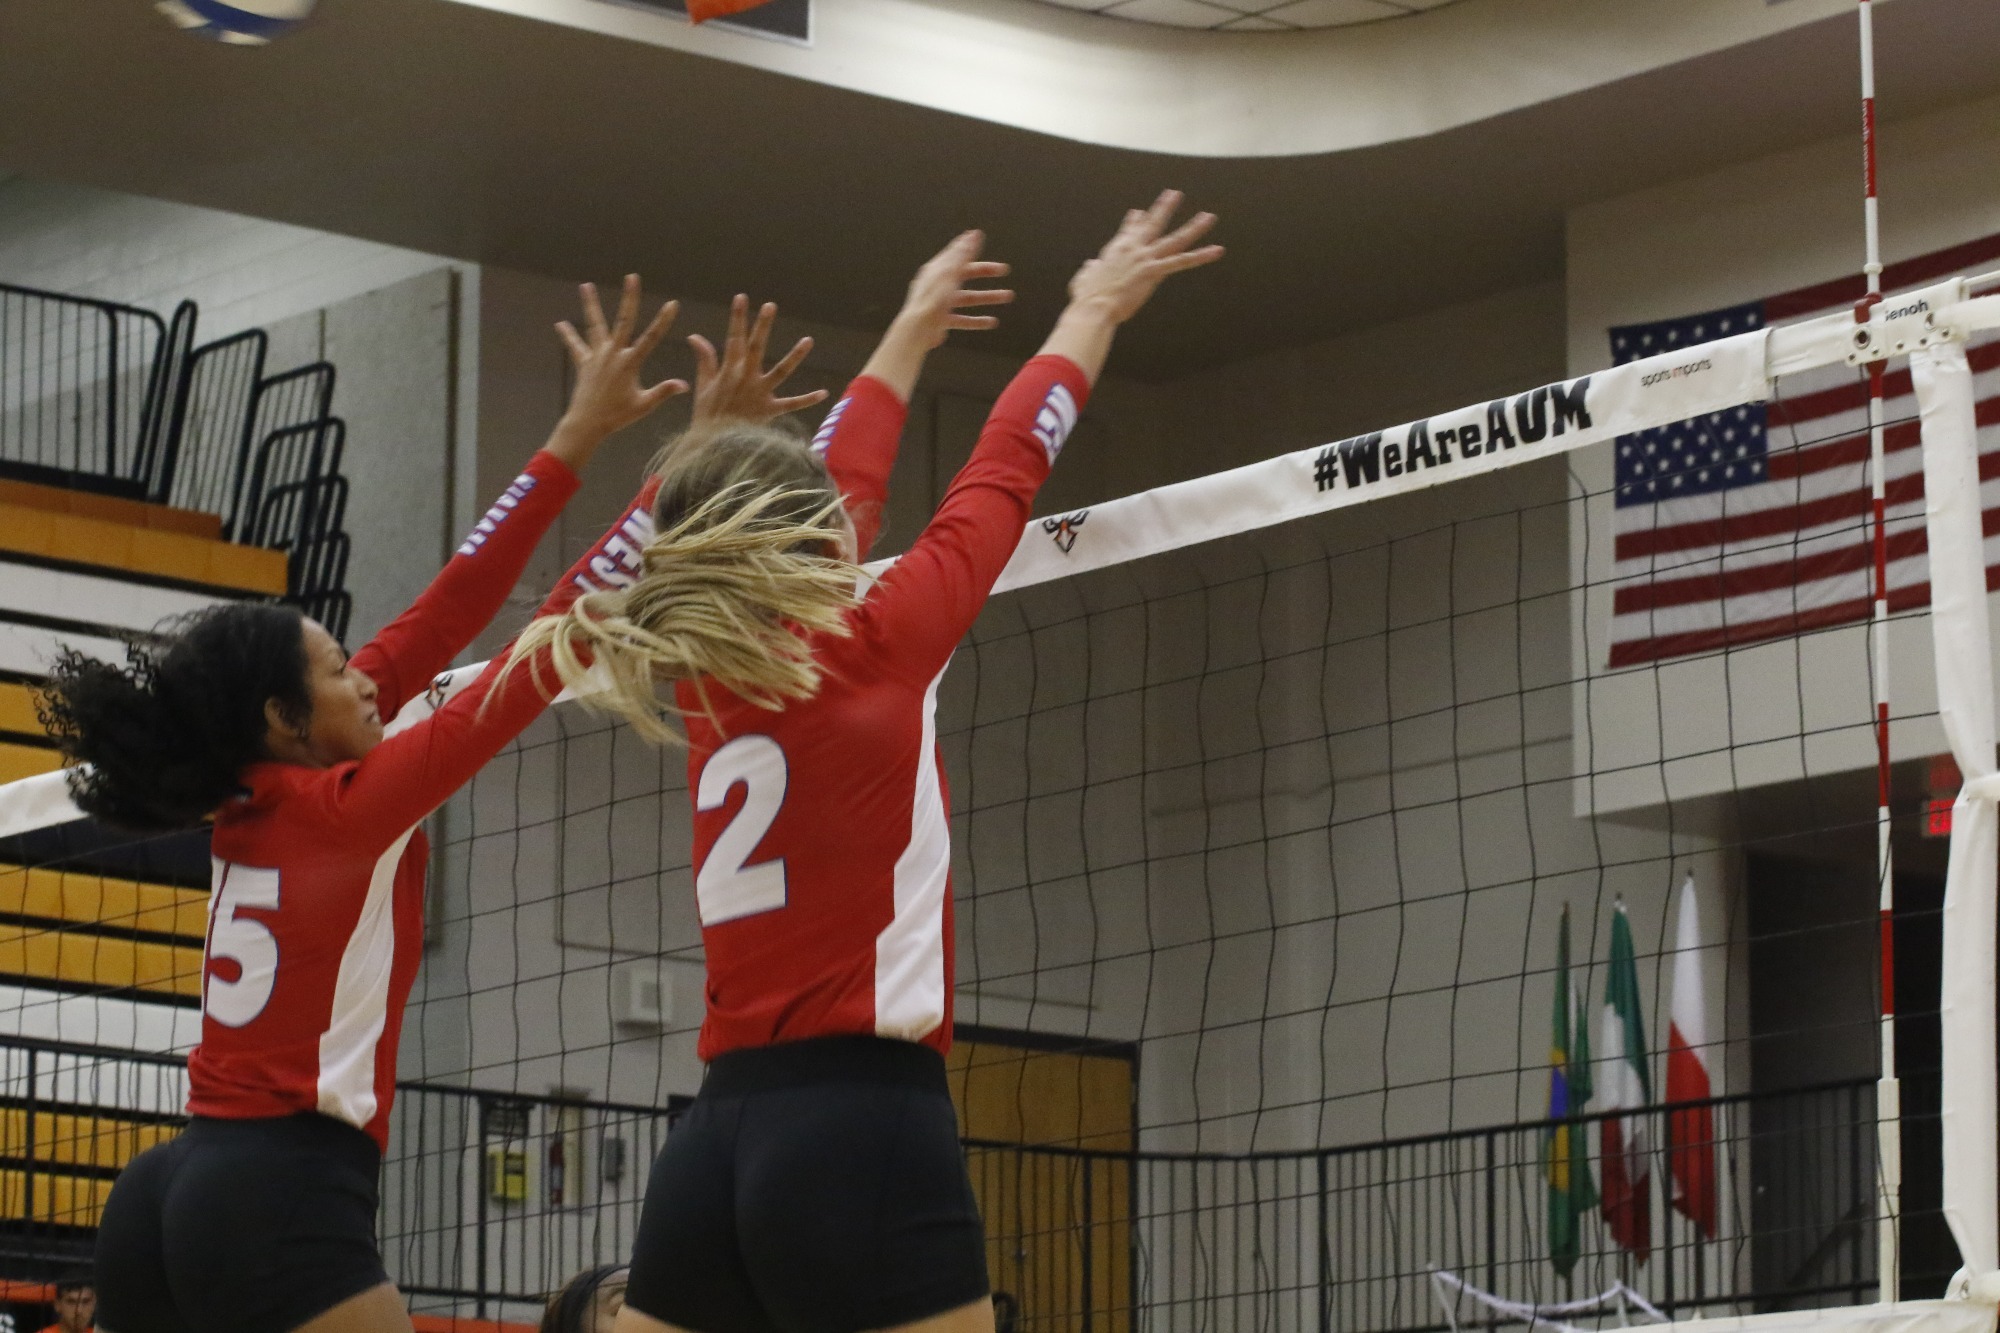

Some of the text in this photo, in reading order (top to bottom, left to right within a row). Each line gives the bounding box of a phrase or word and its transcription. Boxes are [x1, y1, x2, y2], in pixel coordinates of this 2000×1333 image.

[1885, 299, 1929, 321] enoh
[1314, 376, 1592, 492] #WeAreAUM
[696, 733, 789, 927] 2
[201, 856, 281, 1028] 5
